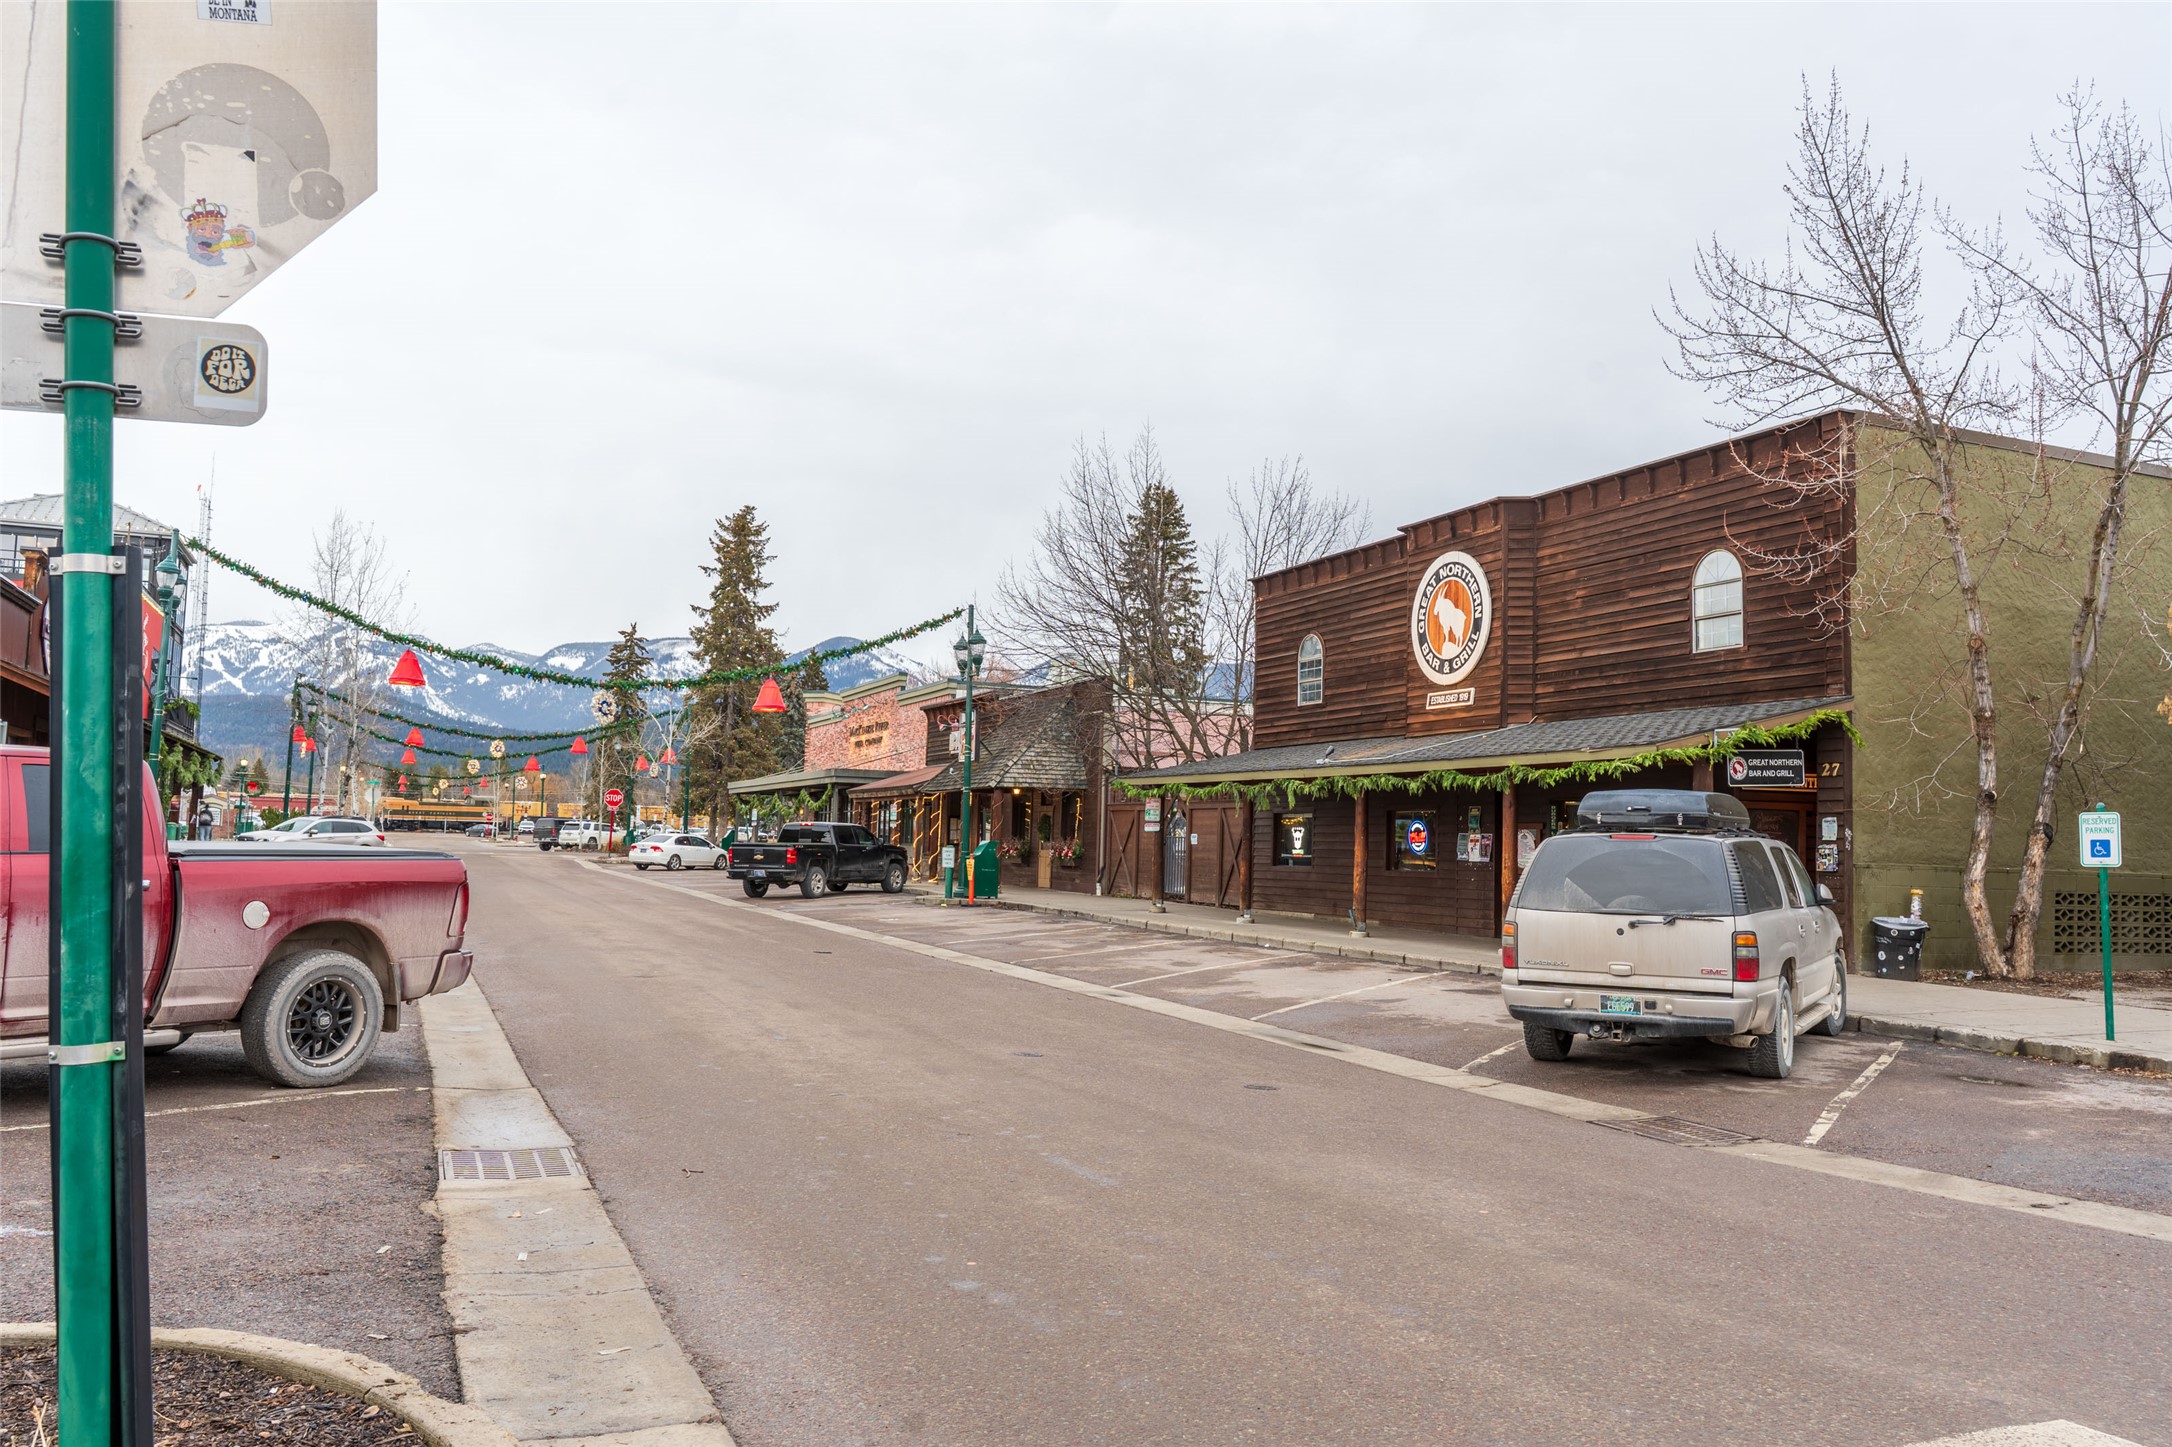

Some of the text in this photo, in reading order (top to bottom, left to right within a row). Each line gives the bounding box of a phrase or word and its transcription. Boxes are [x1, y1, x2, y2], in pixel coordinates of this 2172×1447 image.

[208, 7, 258, 22] MONTANA
[210, 346, 246, 361] DO IT
[205, 359, 251, 380] FOR
[1418, 563, 1483, 634] GREAT NORTHERN
[1421, 630, 1480, 674] BAR & GRILL
[1748, 758, 1803, 767] GREAT NORTHERN
[1748, 769, 1795, 777] BAR AND GRILL
[1821, 763, 1840, 777] 27
[605, 794, 622, 802] STOP
[2082, 817, 2117, 825] RESERVED
[1700, 968, 1728, 977] GMC
